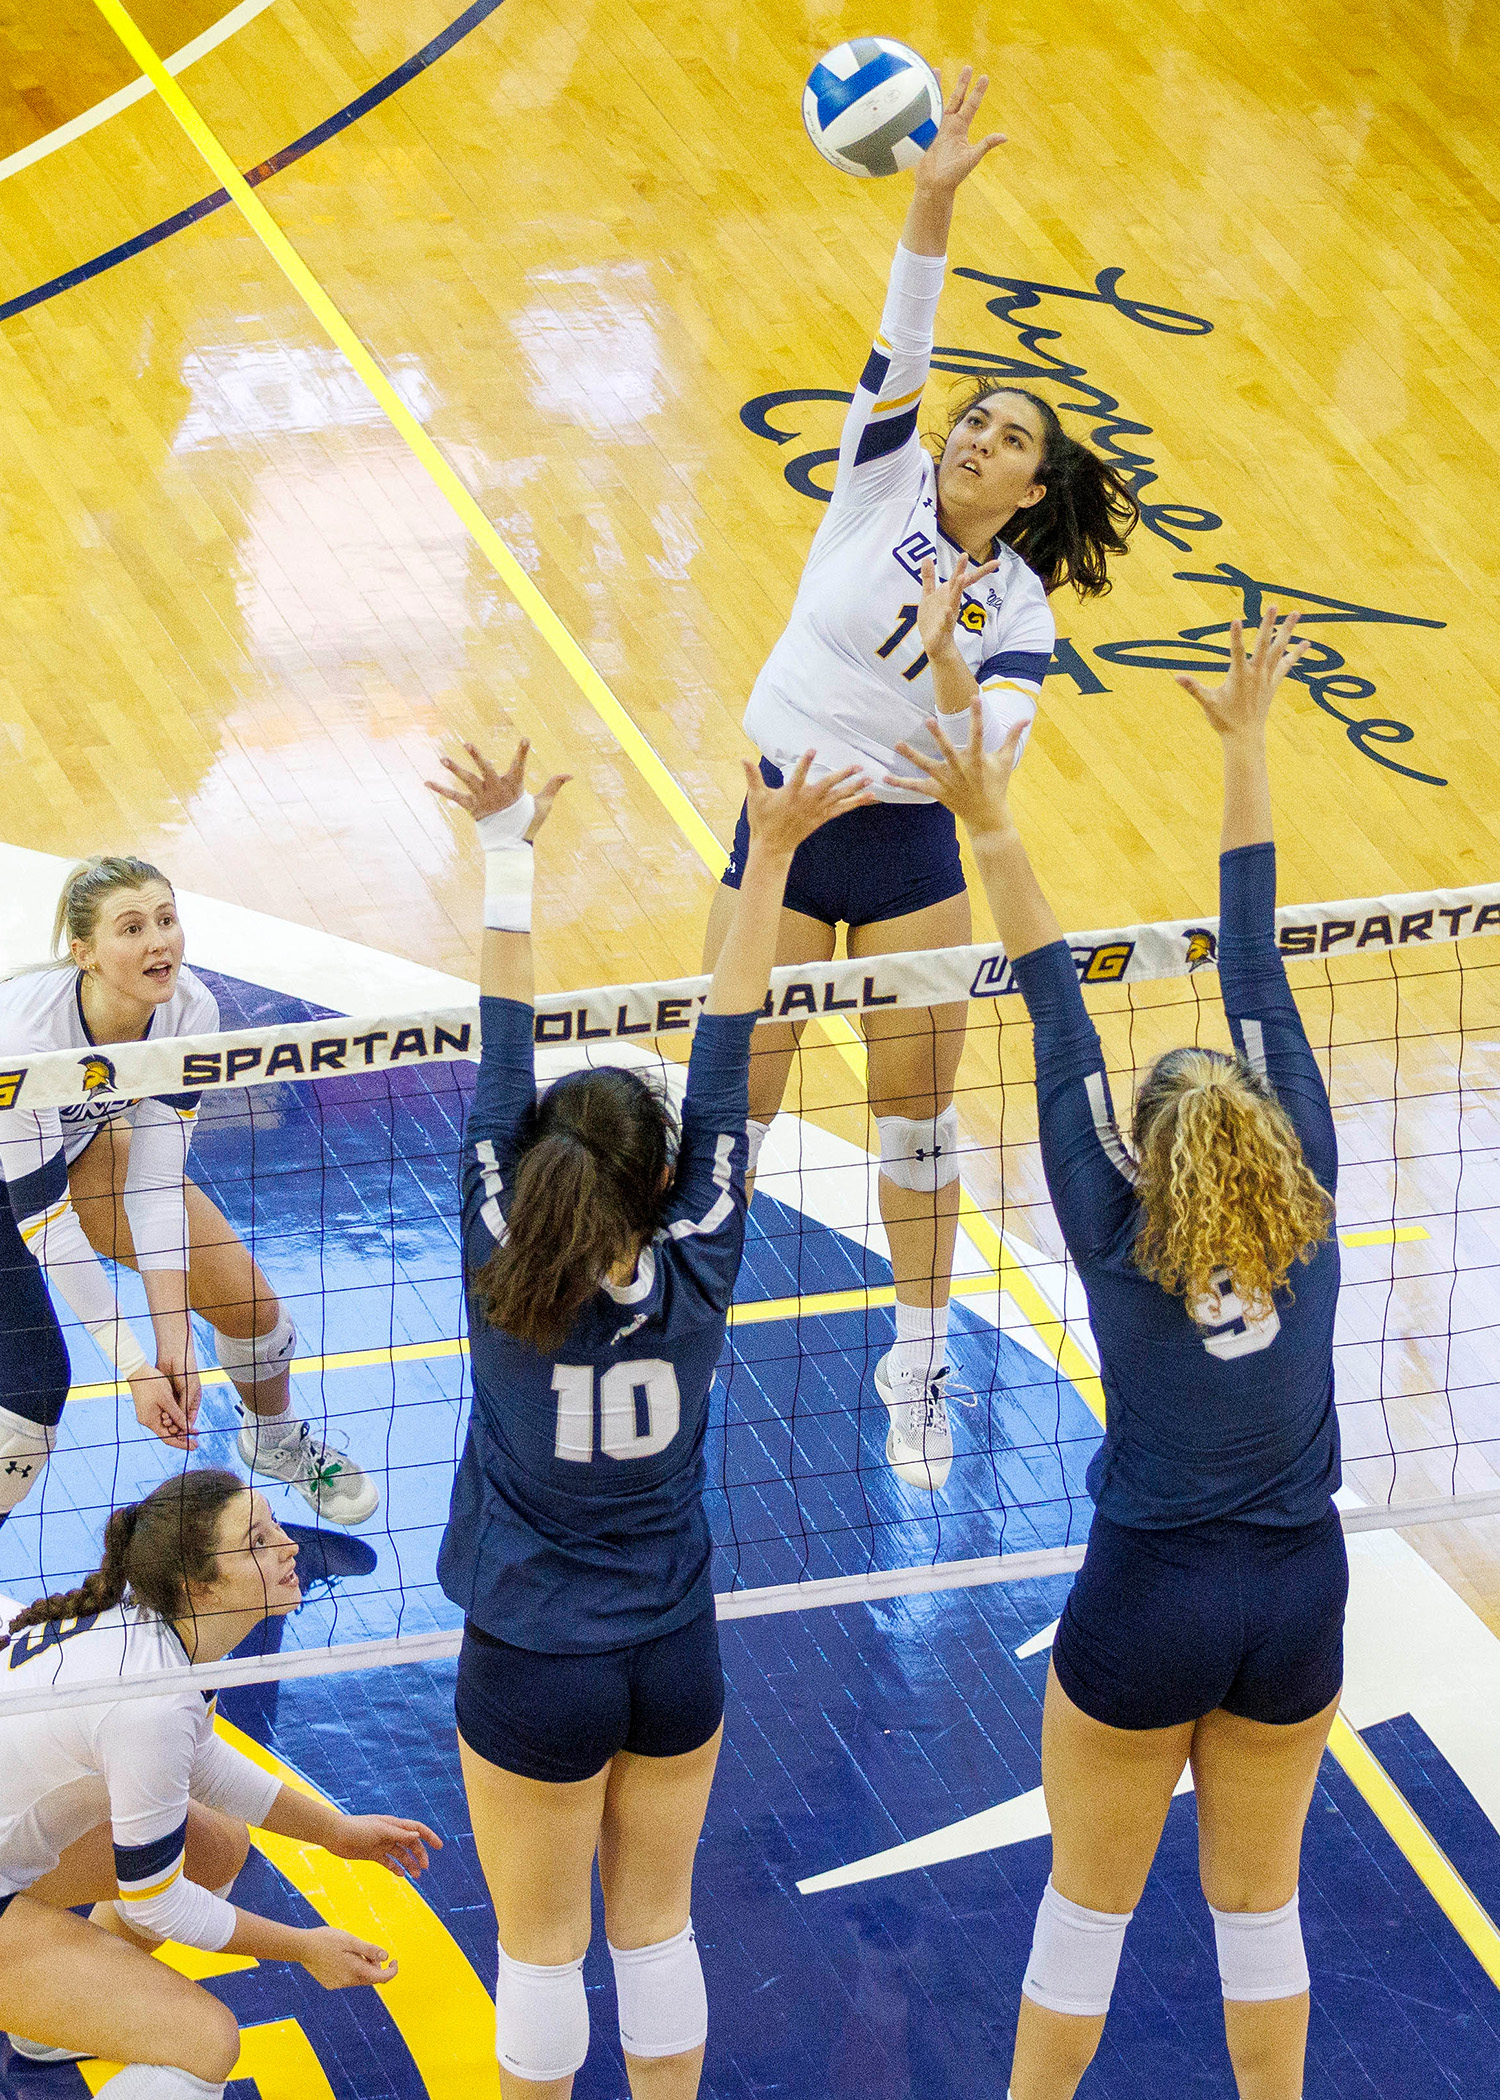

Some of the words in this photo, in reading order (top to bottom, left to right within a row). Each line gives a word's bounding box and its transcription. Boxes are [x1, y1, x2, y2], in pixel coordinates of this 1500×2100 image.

[182, 1022, 472, 1087] SPARTAN
[1190, 1264, 1281, 1361] 9
[550, 1357, 681, 1463] 10
